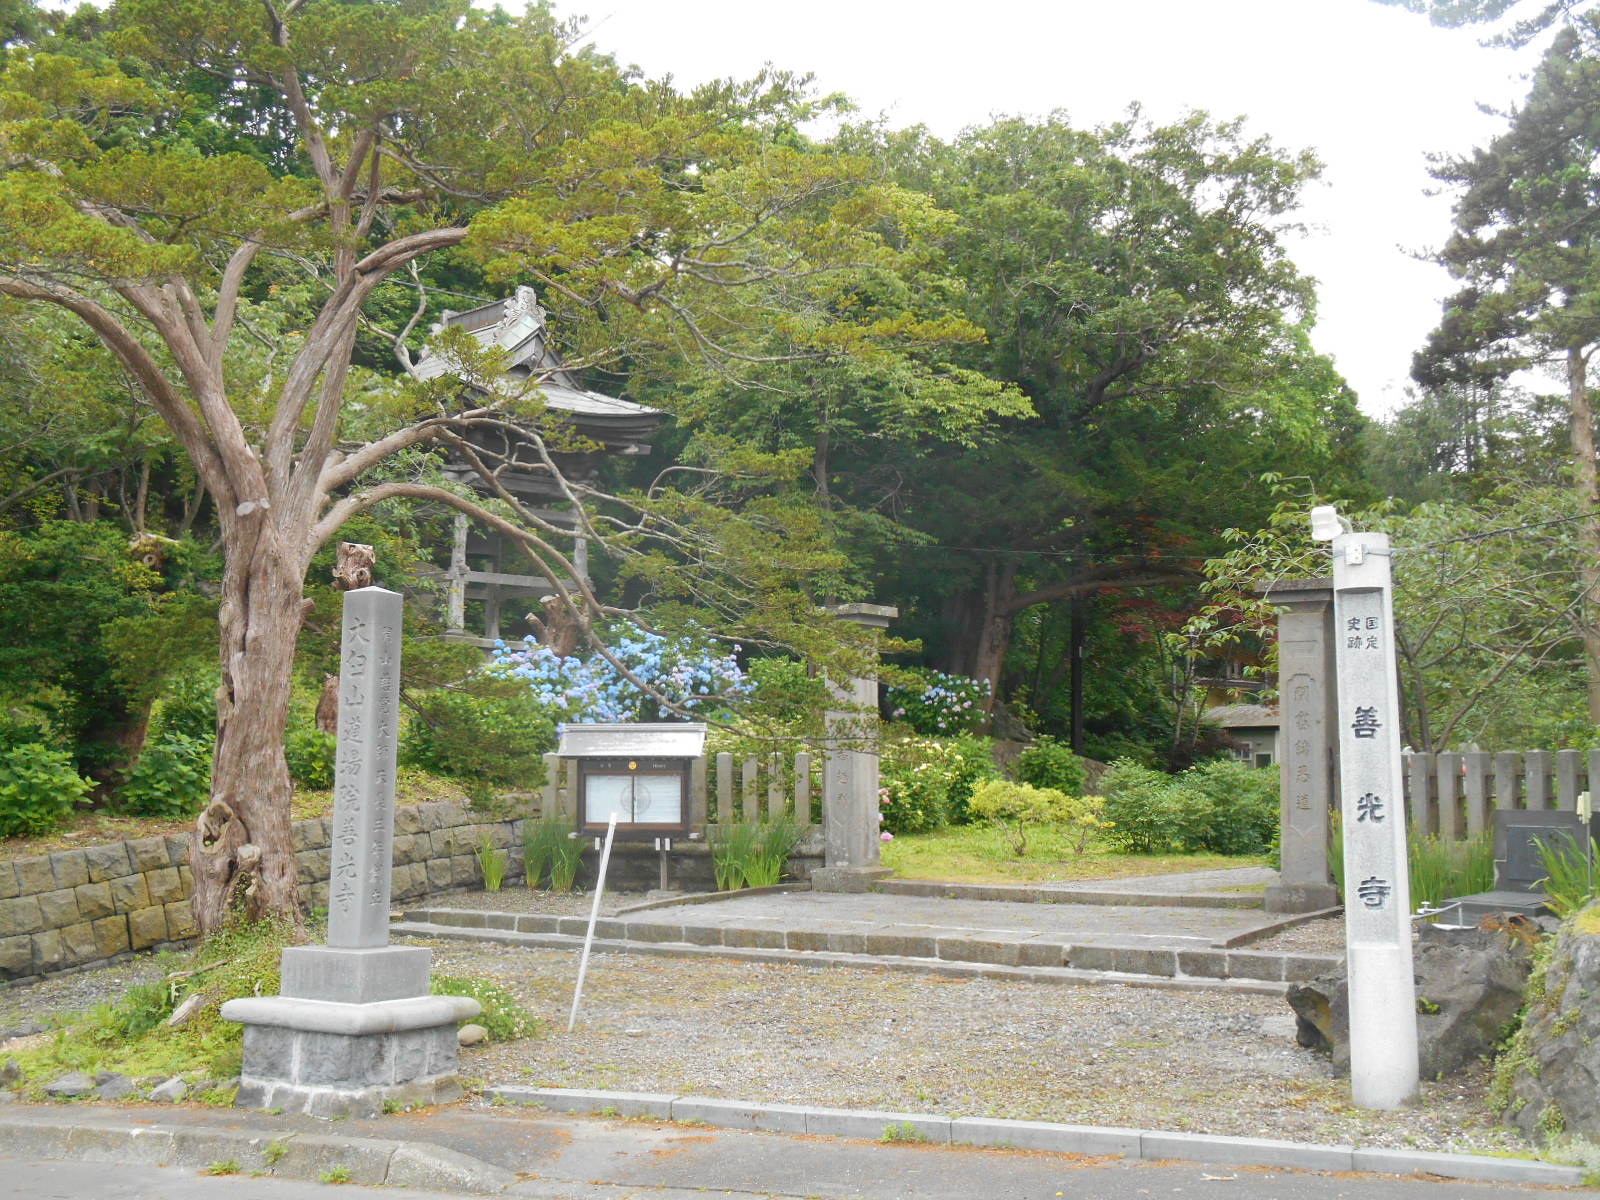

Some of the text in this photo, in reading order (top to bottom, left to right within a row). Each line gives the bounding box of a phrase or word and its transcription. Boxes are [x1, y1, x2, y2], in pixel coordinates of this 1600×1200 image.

[1347, 617, 1363, 649] 史跡
[1365, 616, 1379, 649] 国定
[1351, 706, 1391, 910] 善光寺
